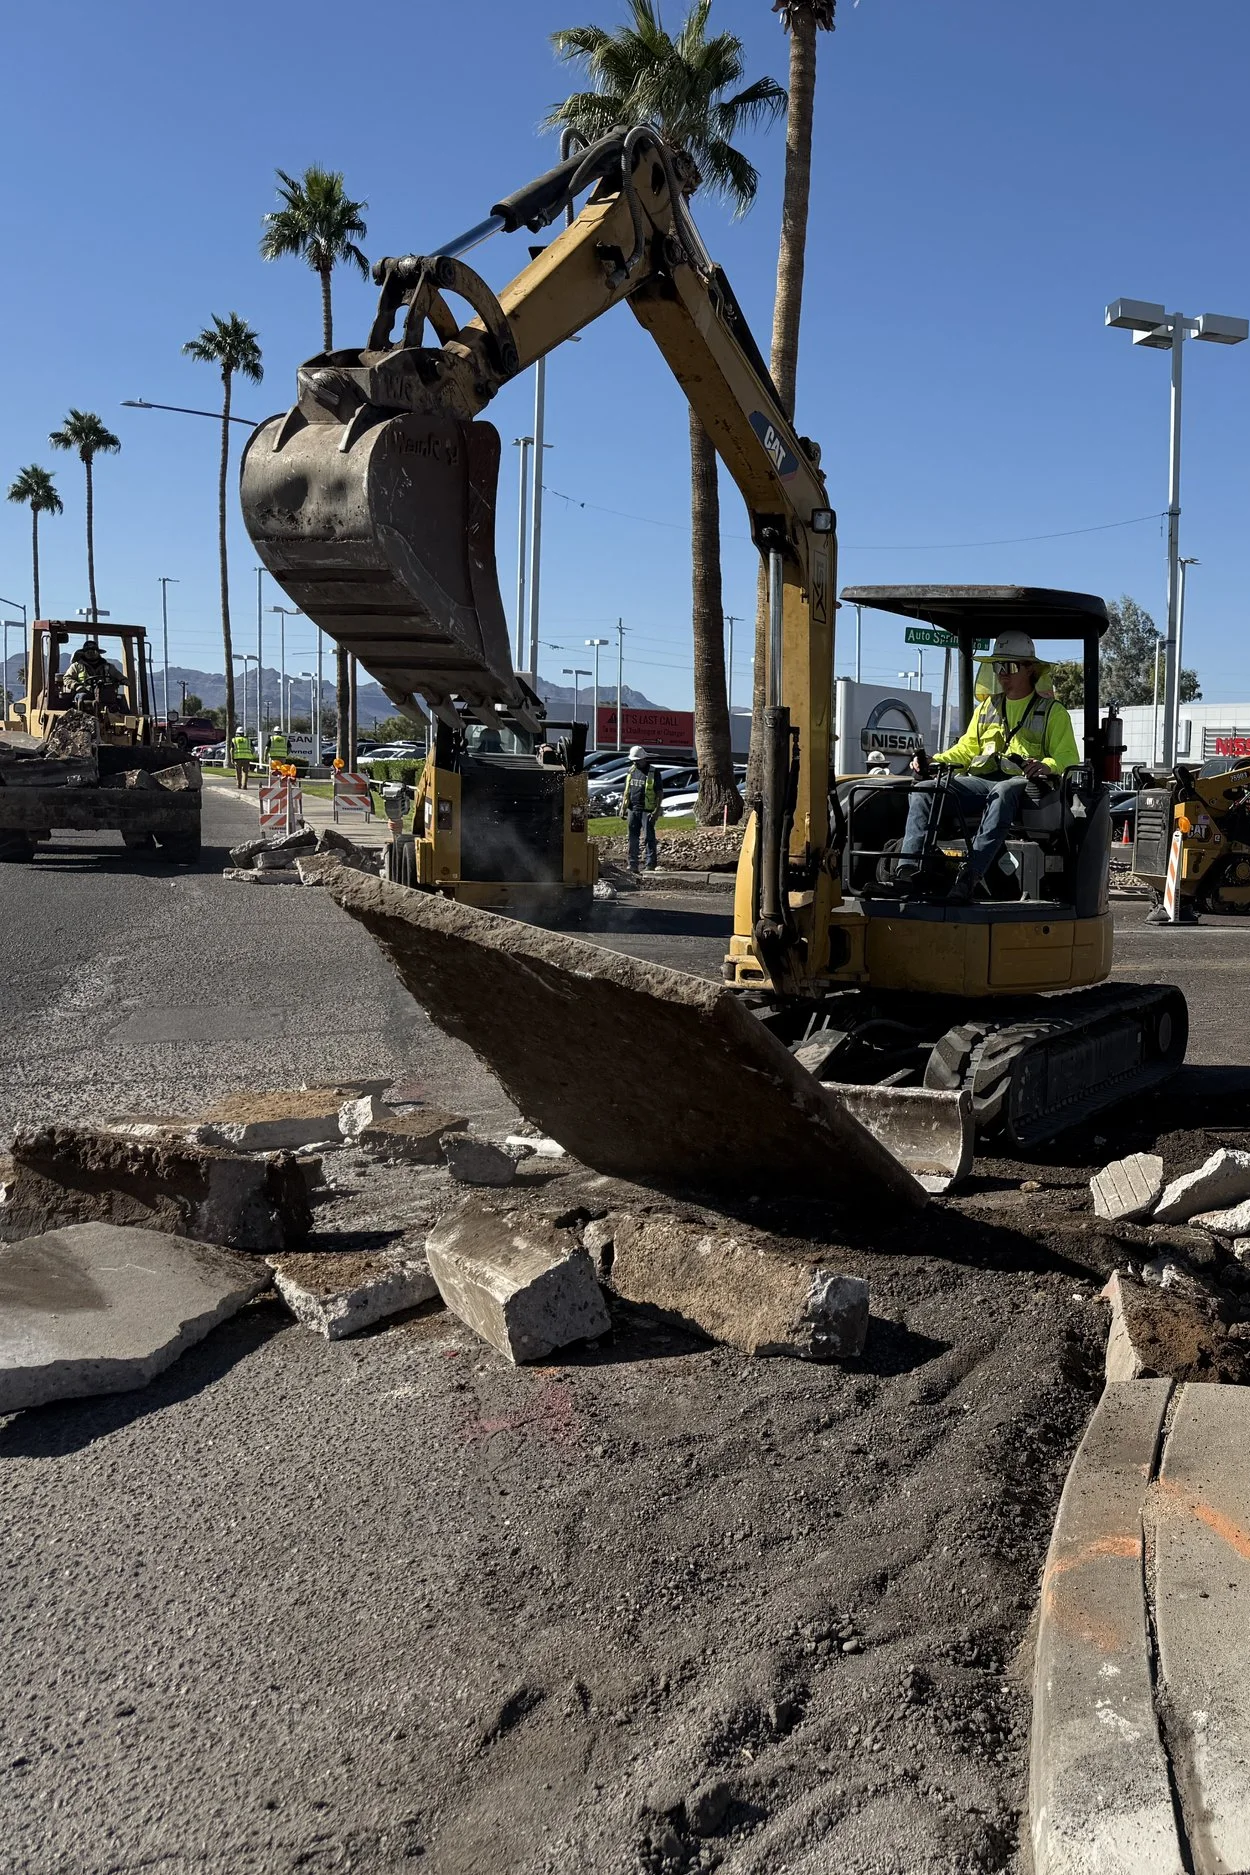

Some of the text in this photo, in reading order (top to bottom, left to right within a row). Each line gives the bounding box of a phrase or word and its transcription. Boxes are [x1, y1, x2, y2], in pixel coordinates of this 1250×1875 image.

[763, 425, 787, 471] CAT
[907, 629, 960, 645] Auto Sprin
[639, 715, 658, 725] LAST
[660, 716, 679, 727] CALL
[288, 735, 313, 743] SAN
[871, 733, 924, 750] NISSAN
[1187, 825, 1207, 839] CAT
